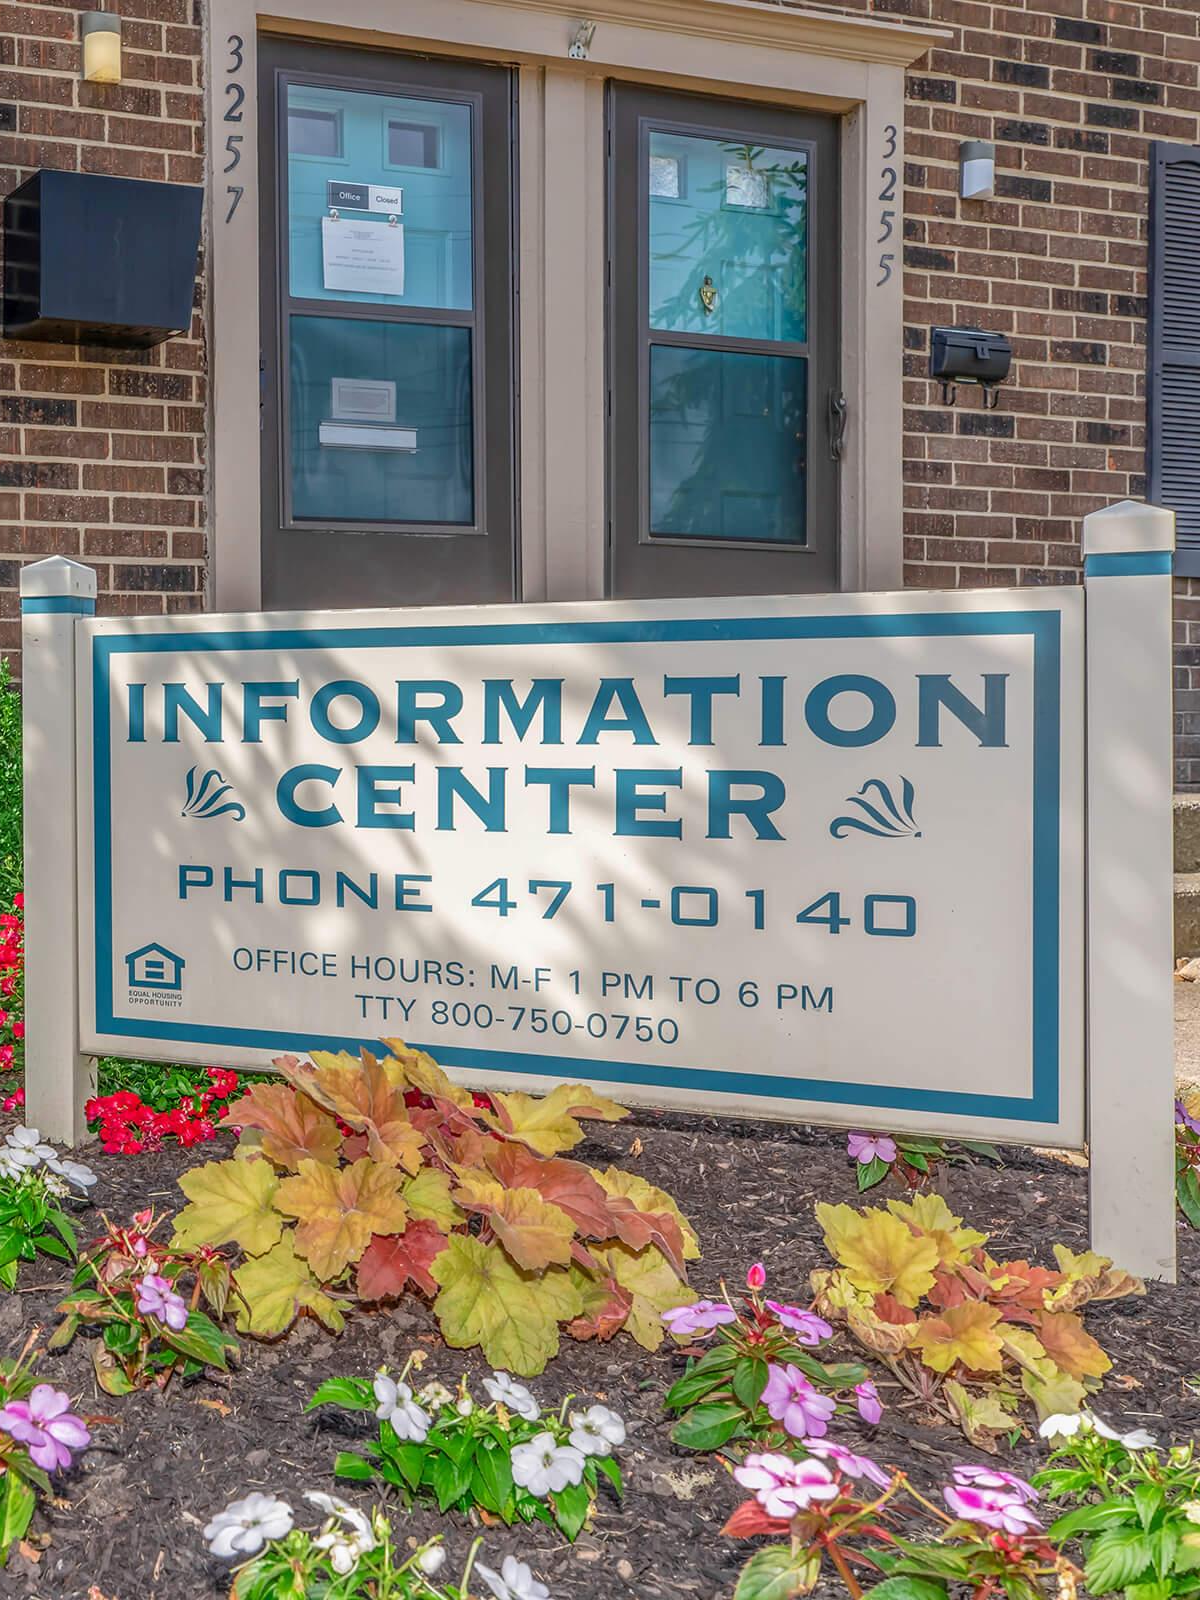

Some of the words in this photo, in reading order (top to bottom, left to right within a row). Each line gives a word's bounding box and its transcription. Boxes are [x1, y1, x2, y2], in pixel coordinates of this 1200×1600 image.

[223, 34, 246, 225] 3257
[338, 191, 361, 201] Office
[375, 195, 399, 205] Closed
[876, 125, 898, 288] 3255
[126, 673, 1010, 748] INFORMATION
[276, 763, 787, 842] CENTER
[179, 864, 434, 913] PHONE
[471, 875, 917, 937] 471-0140
[128, 997, 182, 1007] OPPORTUNITY
[152, 992, 182, 1000] HOUSING
[233, 947, 338, 977] OFFICE
[351, 955, 476, 987] HOURS:
[491, 964, 552, 992] M-F
[569, 970, 580, 995] 1
[601, 972, 654, 1000] PM
[669, 976, 721, 1005] TO
[738, 981, 759, 1008] 6
[777, 984, 833, 1012] PM
[354, 994, 417, 1022] TTY
[431, 1001, 679, 1044] 800-750-0750
